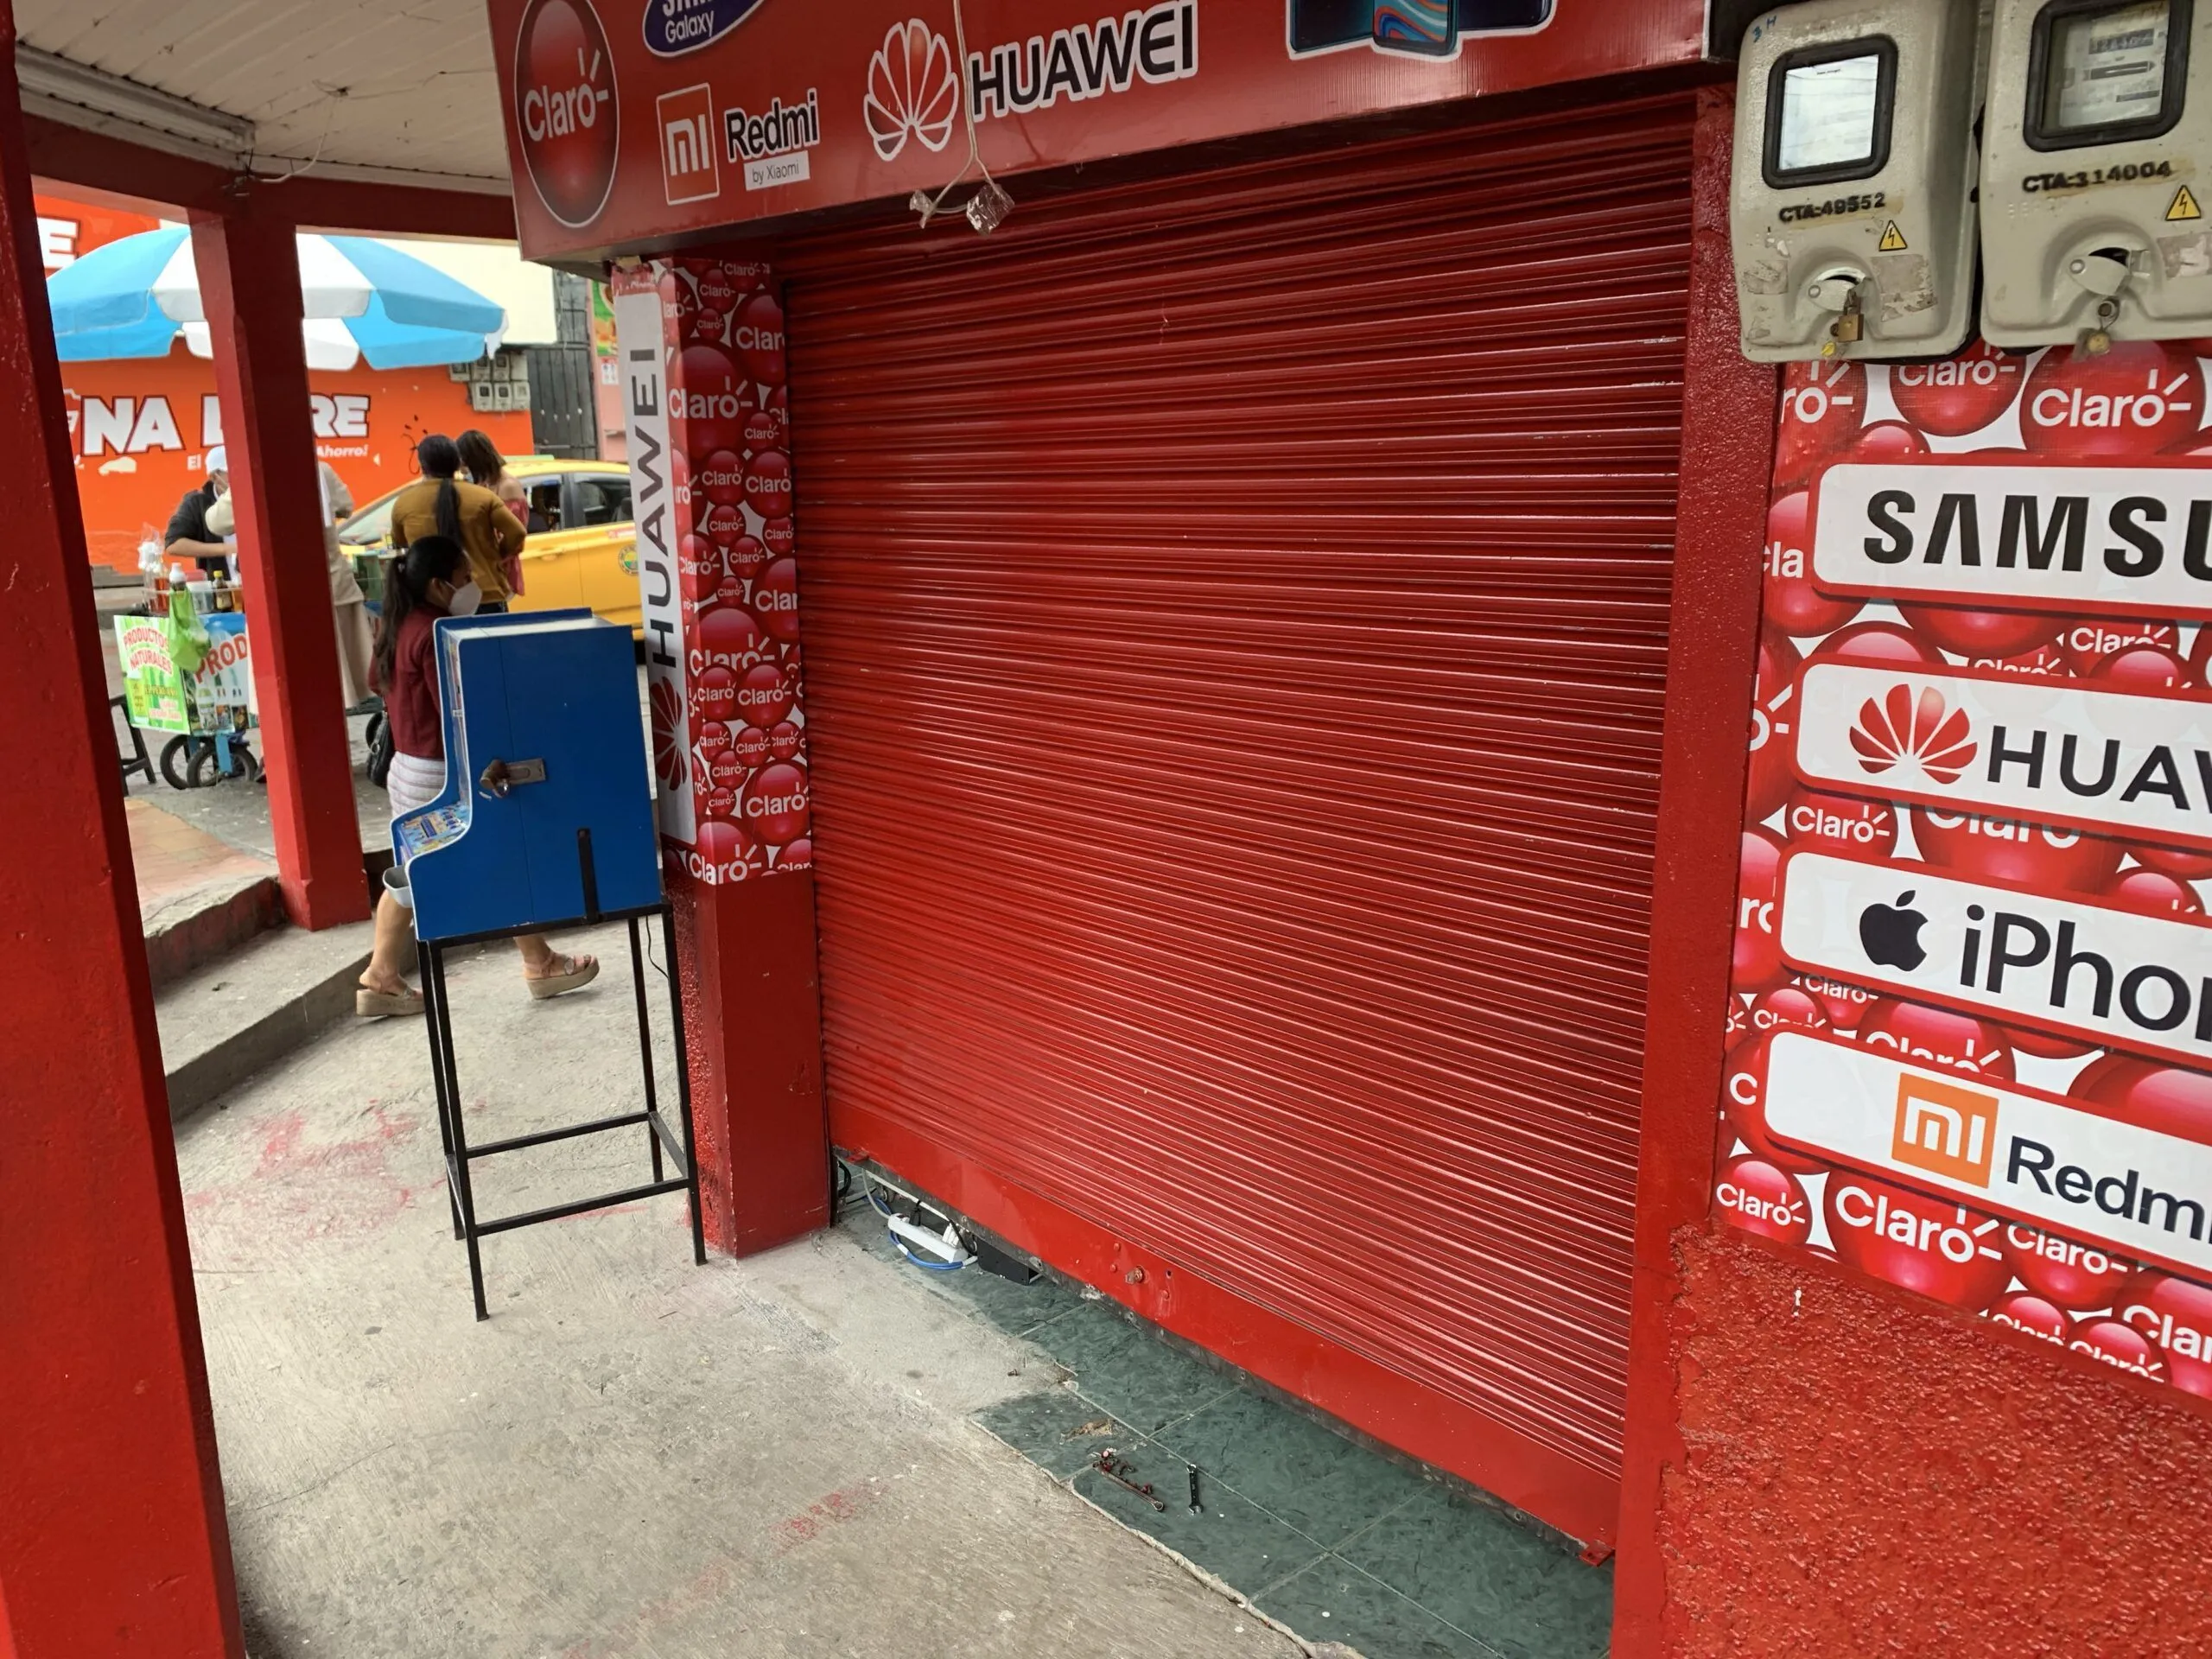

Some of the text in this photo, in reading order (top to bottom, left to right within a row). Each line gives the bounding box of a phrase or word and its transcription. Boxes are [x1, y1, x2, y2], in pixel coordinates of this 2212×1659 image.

[665, 10, 715, 43] Galaxy
[972, 4, 1192, 115] HUAWEI
[524, 85, 596, 143] Claro
[726, 92, 817, 159] Redmi
[752, 159, 799, 185] by Xiaomi
[736, 327, 785, 351] Clar
[2031, 388, 2165, 427] Claro
[630, 349, 677, 668] HUAWEI
[194, 634, 248, 683] PROD
[1986, 725, 2212, 814] HUA
[747, 794, 805, 817] Claro
[1791, 805, 1873, 843] Claro
[1716, 1183, 1791, 1226] Claro
[2006, 1135, 2212, 1243] Redm
[1835, 1186, 1975, 1263] Claro
[2007, 1221, 2109, 1274] Claro
